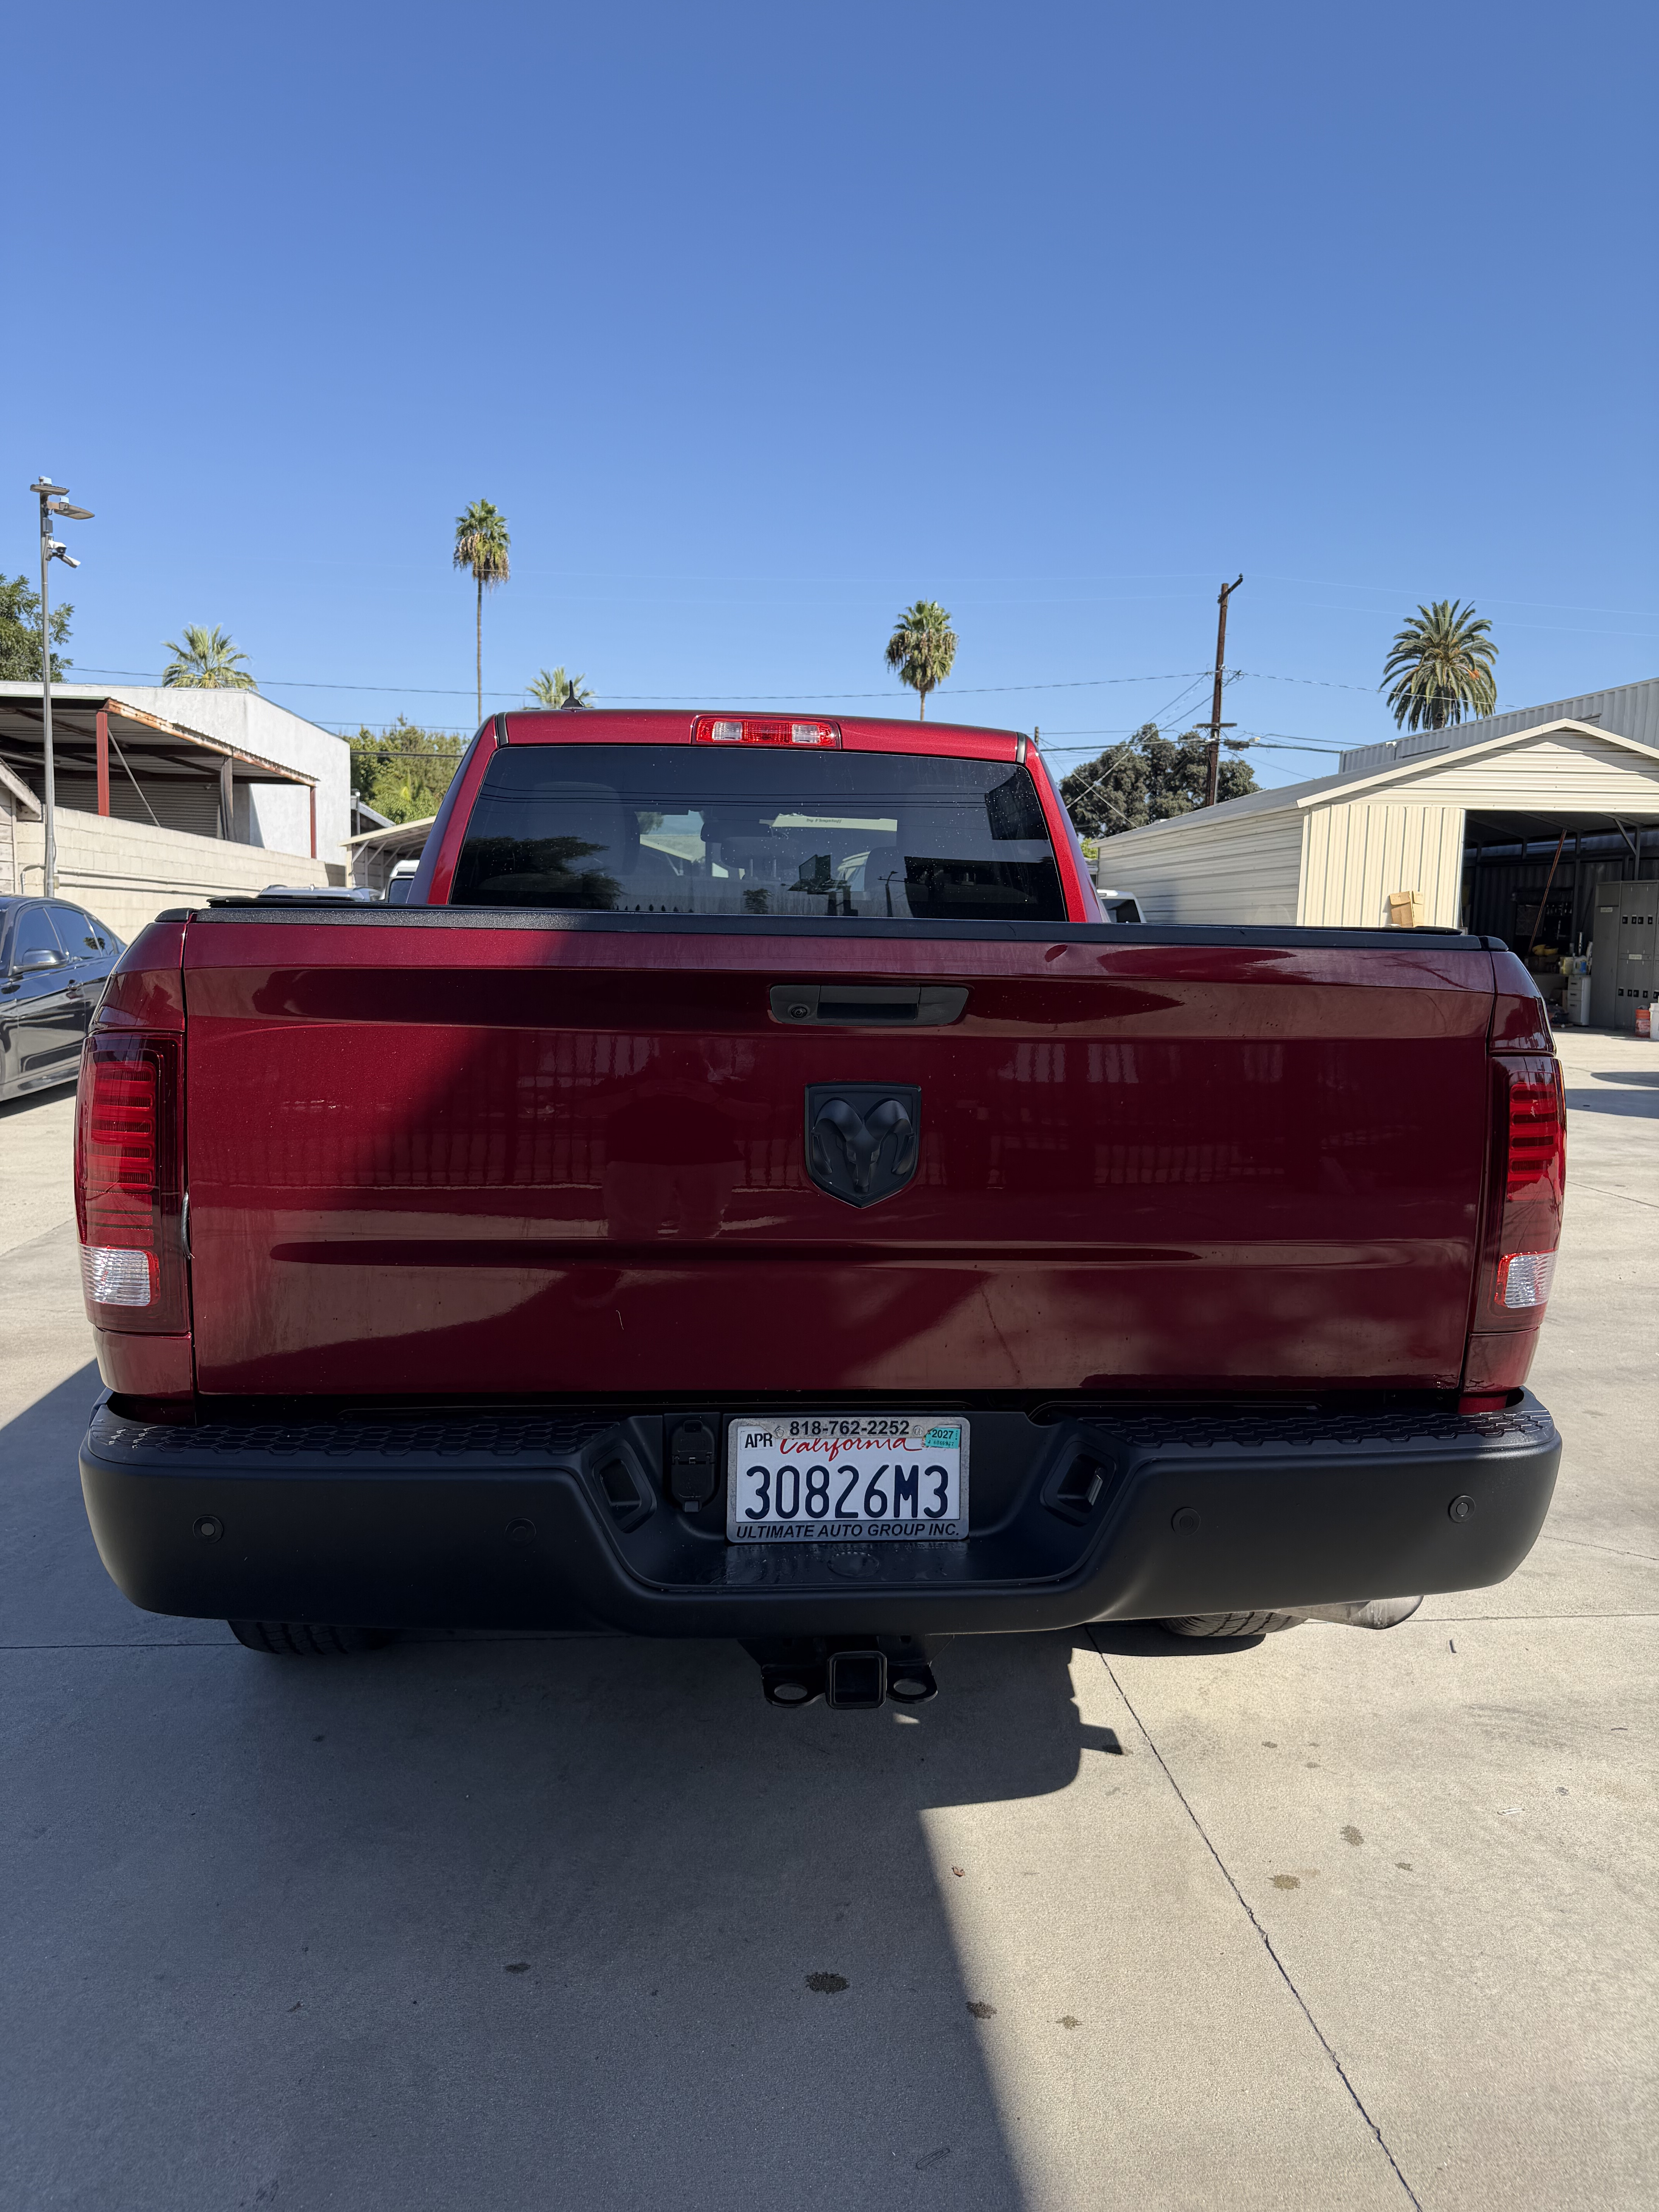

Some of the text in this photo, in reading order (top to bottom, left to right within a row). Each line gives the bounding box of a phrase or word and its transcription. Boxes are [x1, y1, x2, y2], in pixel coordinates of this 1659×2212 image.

[790, 1420, 909, 1435] 818-762-2252
[932, 1429, 954, 1439] 2027
[745, 1433, 773, 1448] APR
[780, 1438, 922, 1461] California
[745, 1465, 948, 1519] 30826M3
[737, 1523, 960, 1538] ULTIMATE AUTO GROUP INC.
